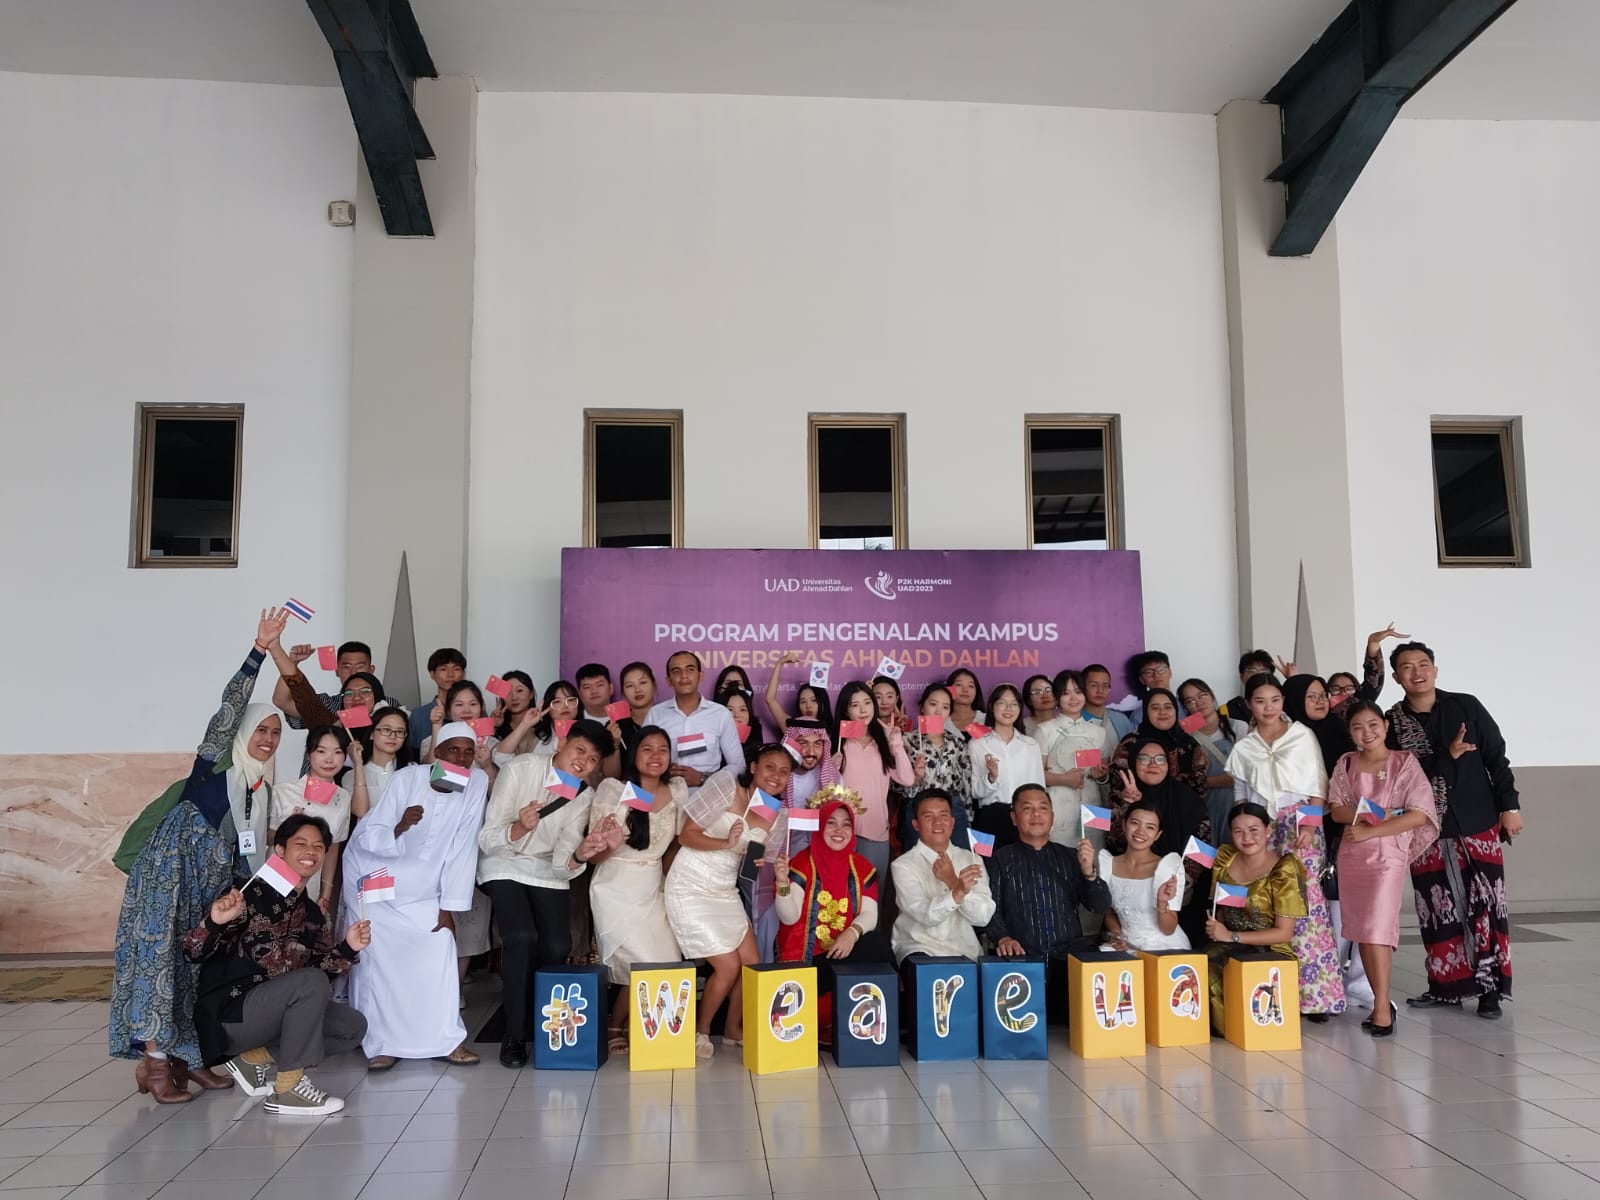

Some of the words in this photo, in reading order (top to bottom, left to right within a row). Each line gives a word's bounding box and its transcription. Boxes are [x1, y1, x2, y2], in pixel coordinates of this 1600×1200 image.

[764, 578, 800, 592] UAD
[802, 578, 841, 586] Universitas
[913, 578, 952, 586] HARMONI
[654, 623, 779, 643] PROGRAM
[787, 622, 951, 642] PENGENALAN
[958, 622, 1059, 642] KAMPUS
[688, 649, 835, 669] NIVERSITAS
[939, 649, 1040, 667] DAHLAN
